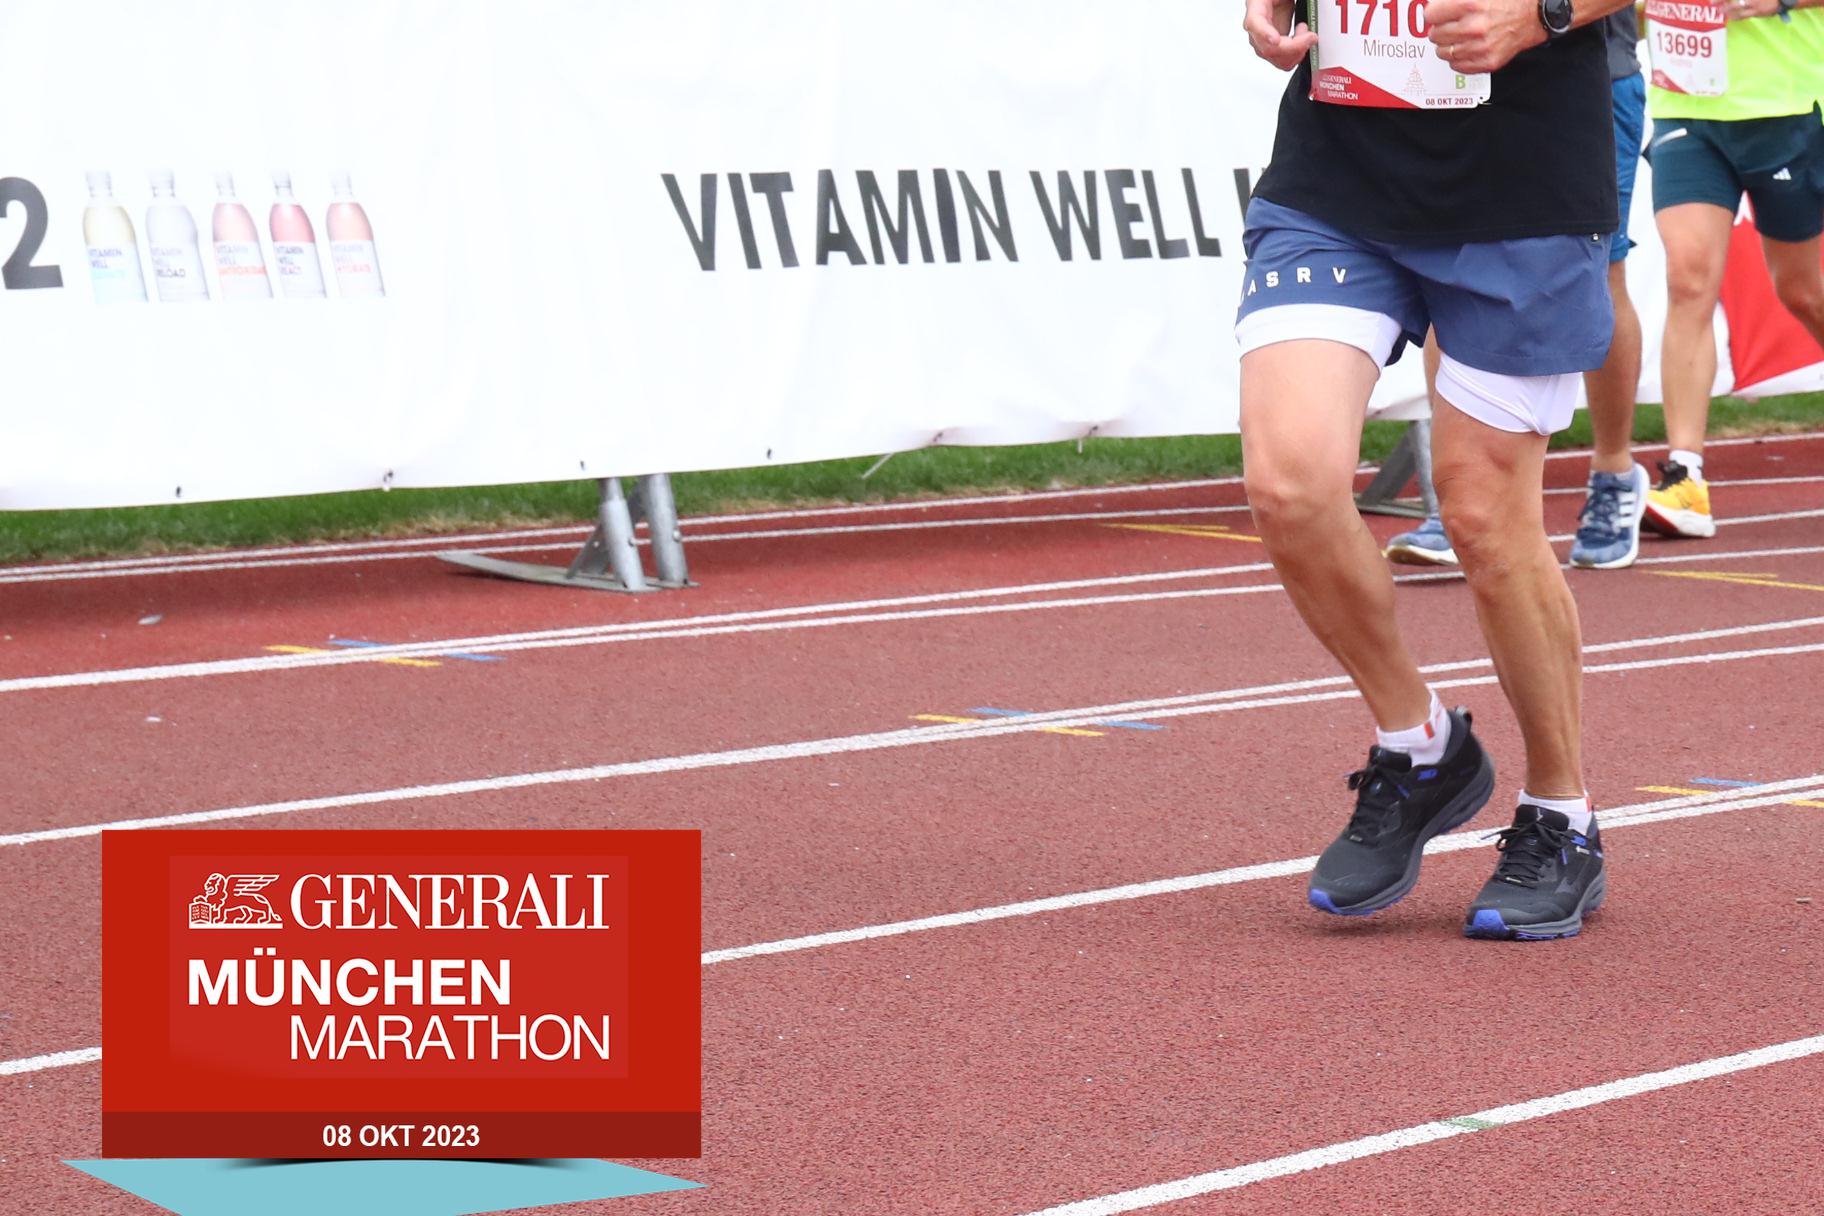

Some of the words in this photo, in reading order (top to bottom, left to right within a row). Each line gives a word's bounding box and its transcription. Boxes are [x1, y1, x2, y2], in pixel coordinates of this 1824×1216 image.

[1363, 39, 1426, 58] Miroslav
[1656, 31, 1713, 58] 13699
[1455, 74, 1467, 90] B
[1425, 98, 1436, 106] 08
[1437, 98, 1453, 106] OKT
[1454, 97, 1474, 105] 2023
[661, 168, 1019, 272] VITAMIN
[1030, 167, 1220, 262] WELL
[0, 176, 64, 291] 2
